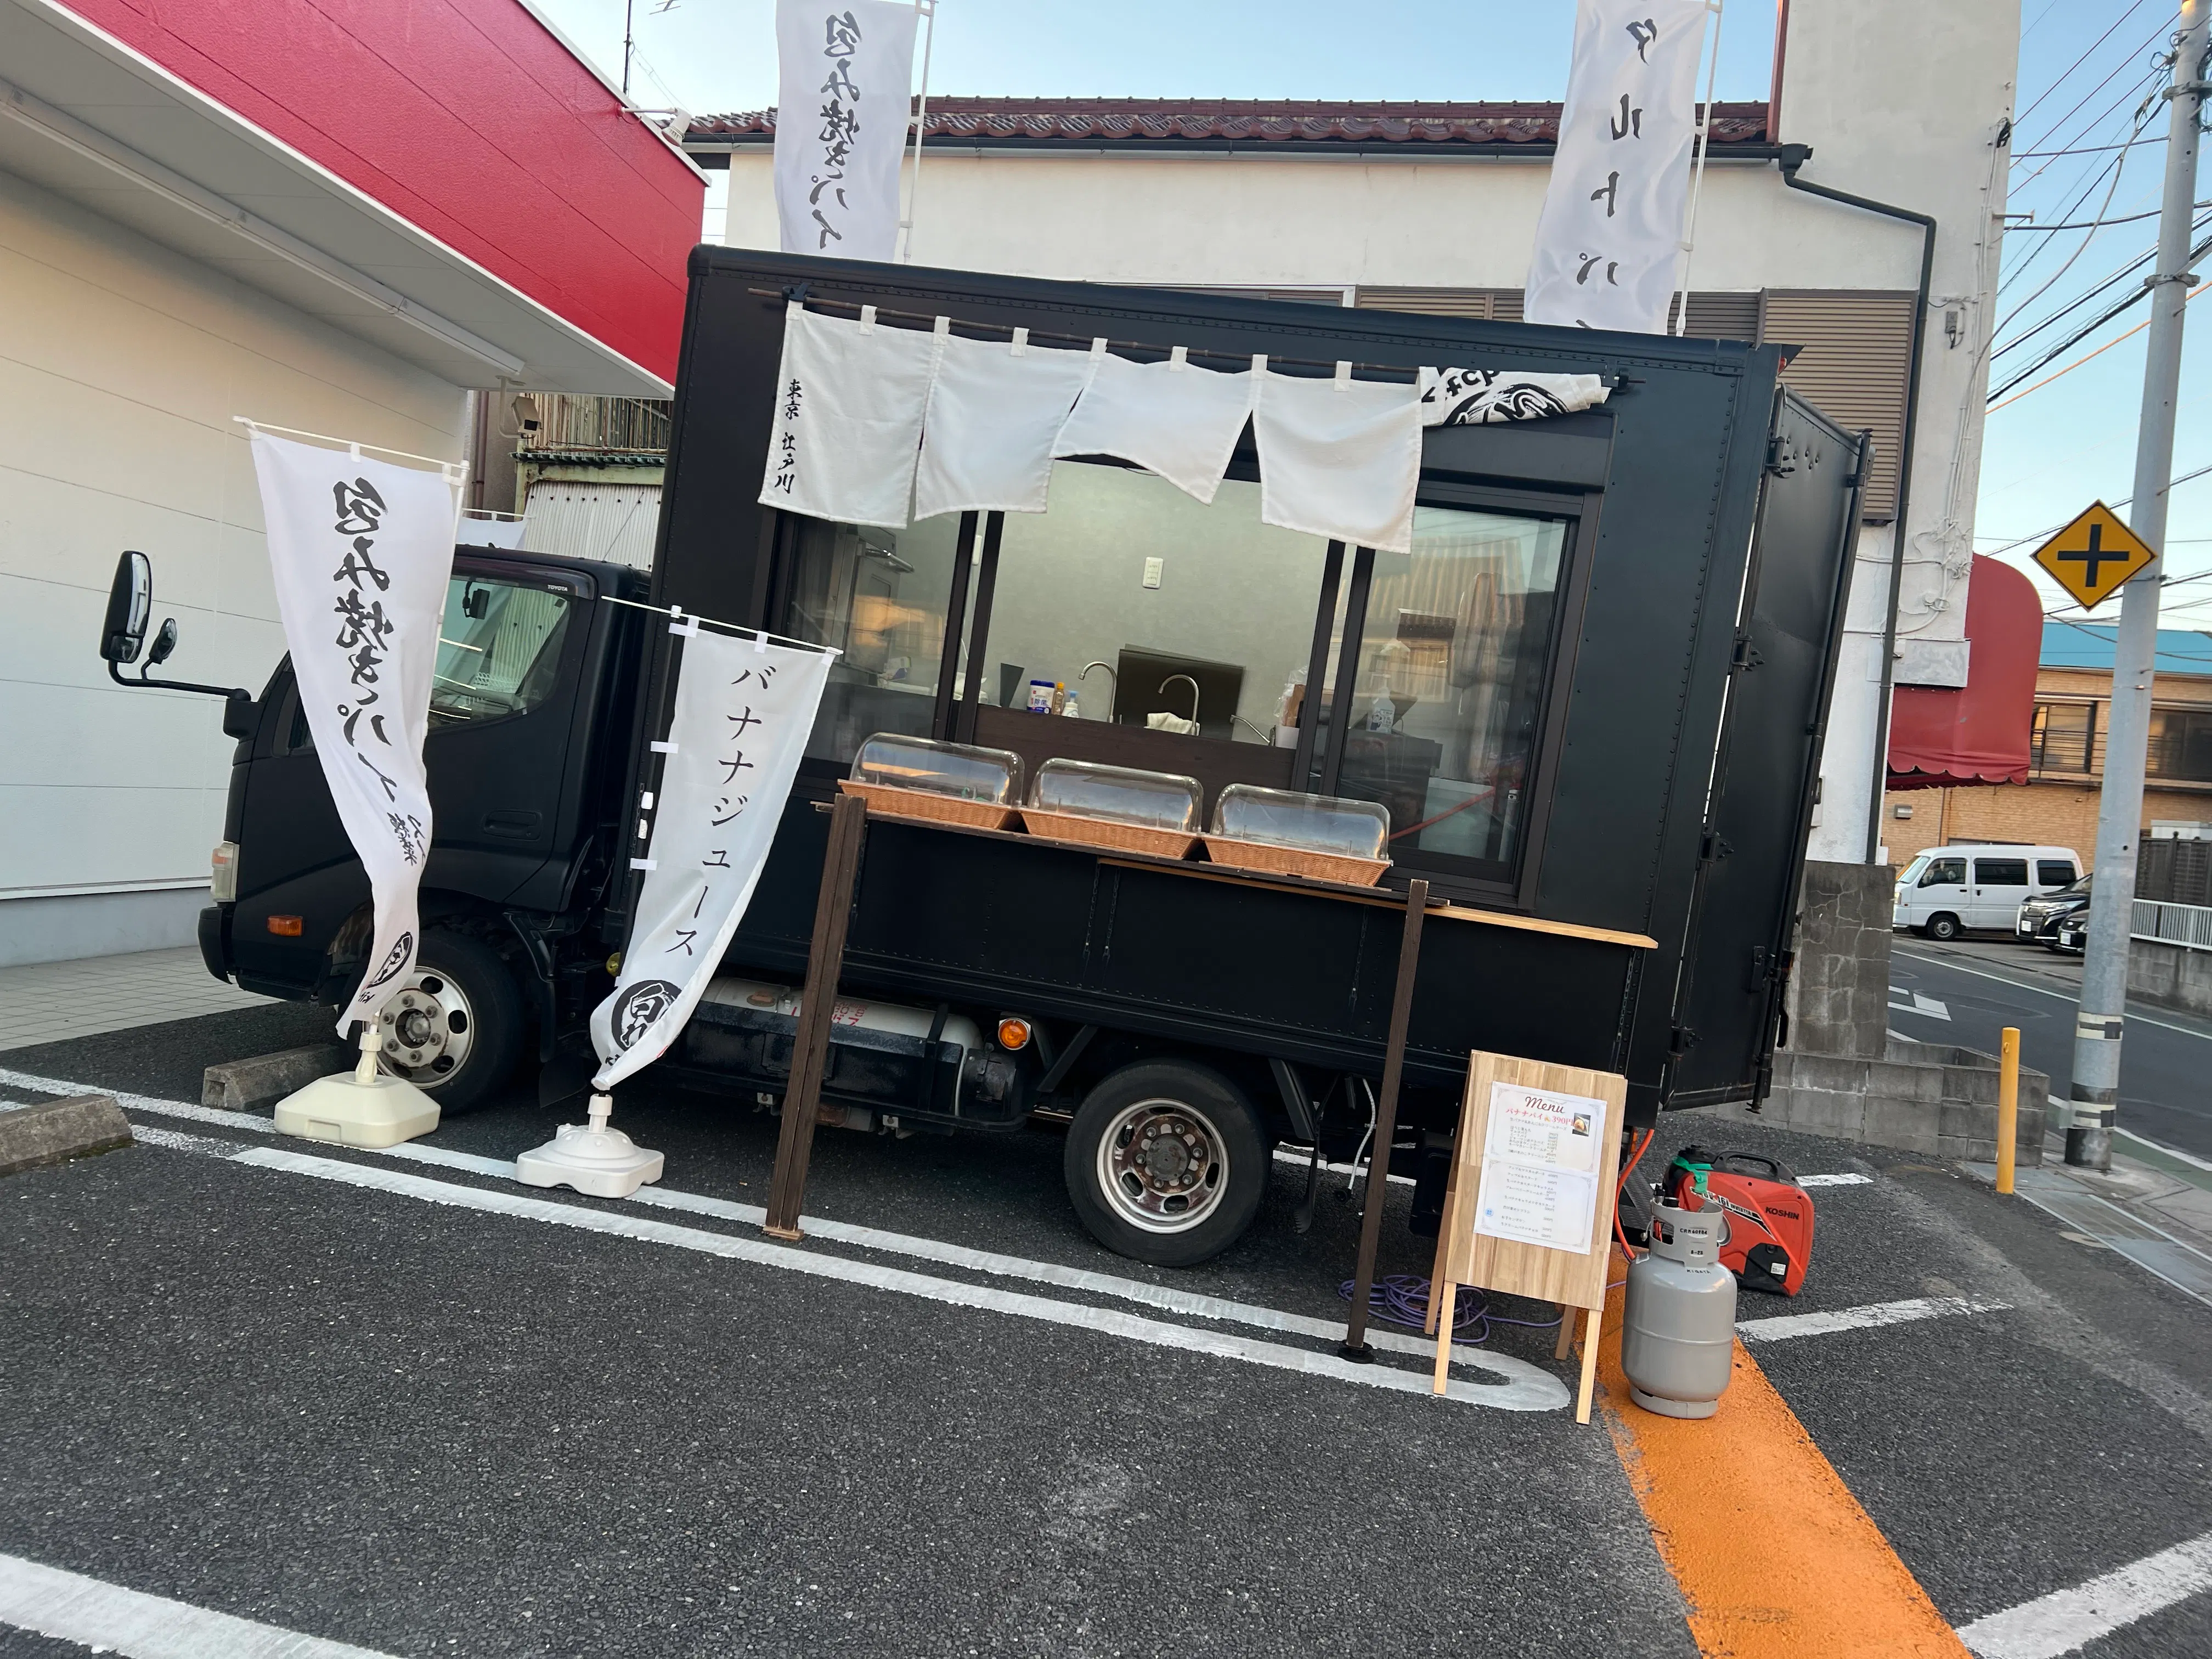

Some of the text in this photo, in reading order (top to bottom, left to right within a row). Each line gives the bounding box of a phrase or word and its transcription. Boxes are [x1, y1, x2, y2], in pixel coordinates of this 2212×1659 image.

[775, 379, 803, 494] 東京 江戸川
[664, 665, 776, 956] バナナジュース
[1525, 1096, 1565, 1113] Menu
[1506, 1108, 1543, 1120] バナナパイ
[1765, 1206, 1799, 1220] KOSHIN
